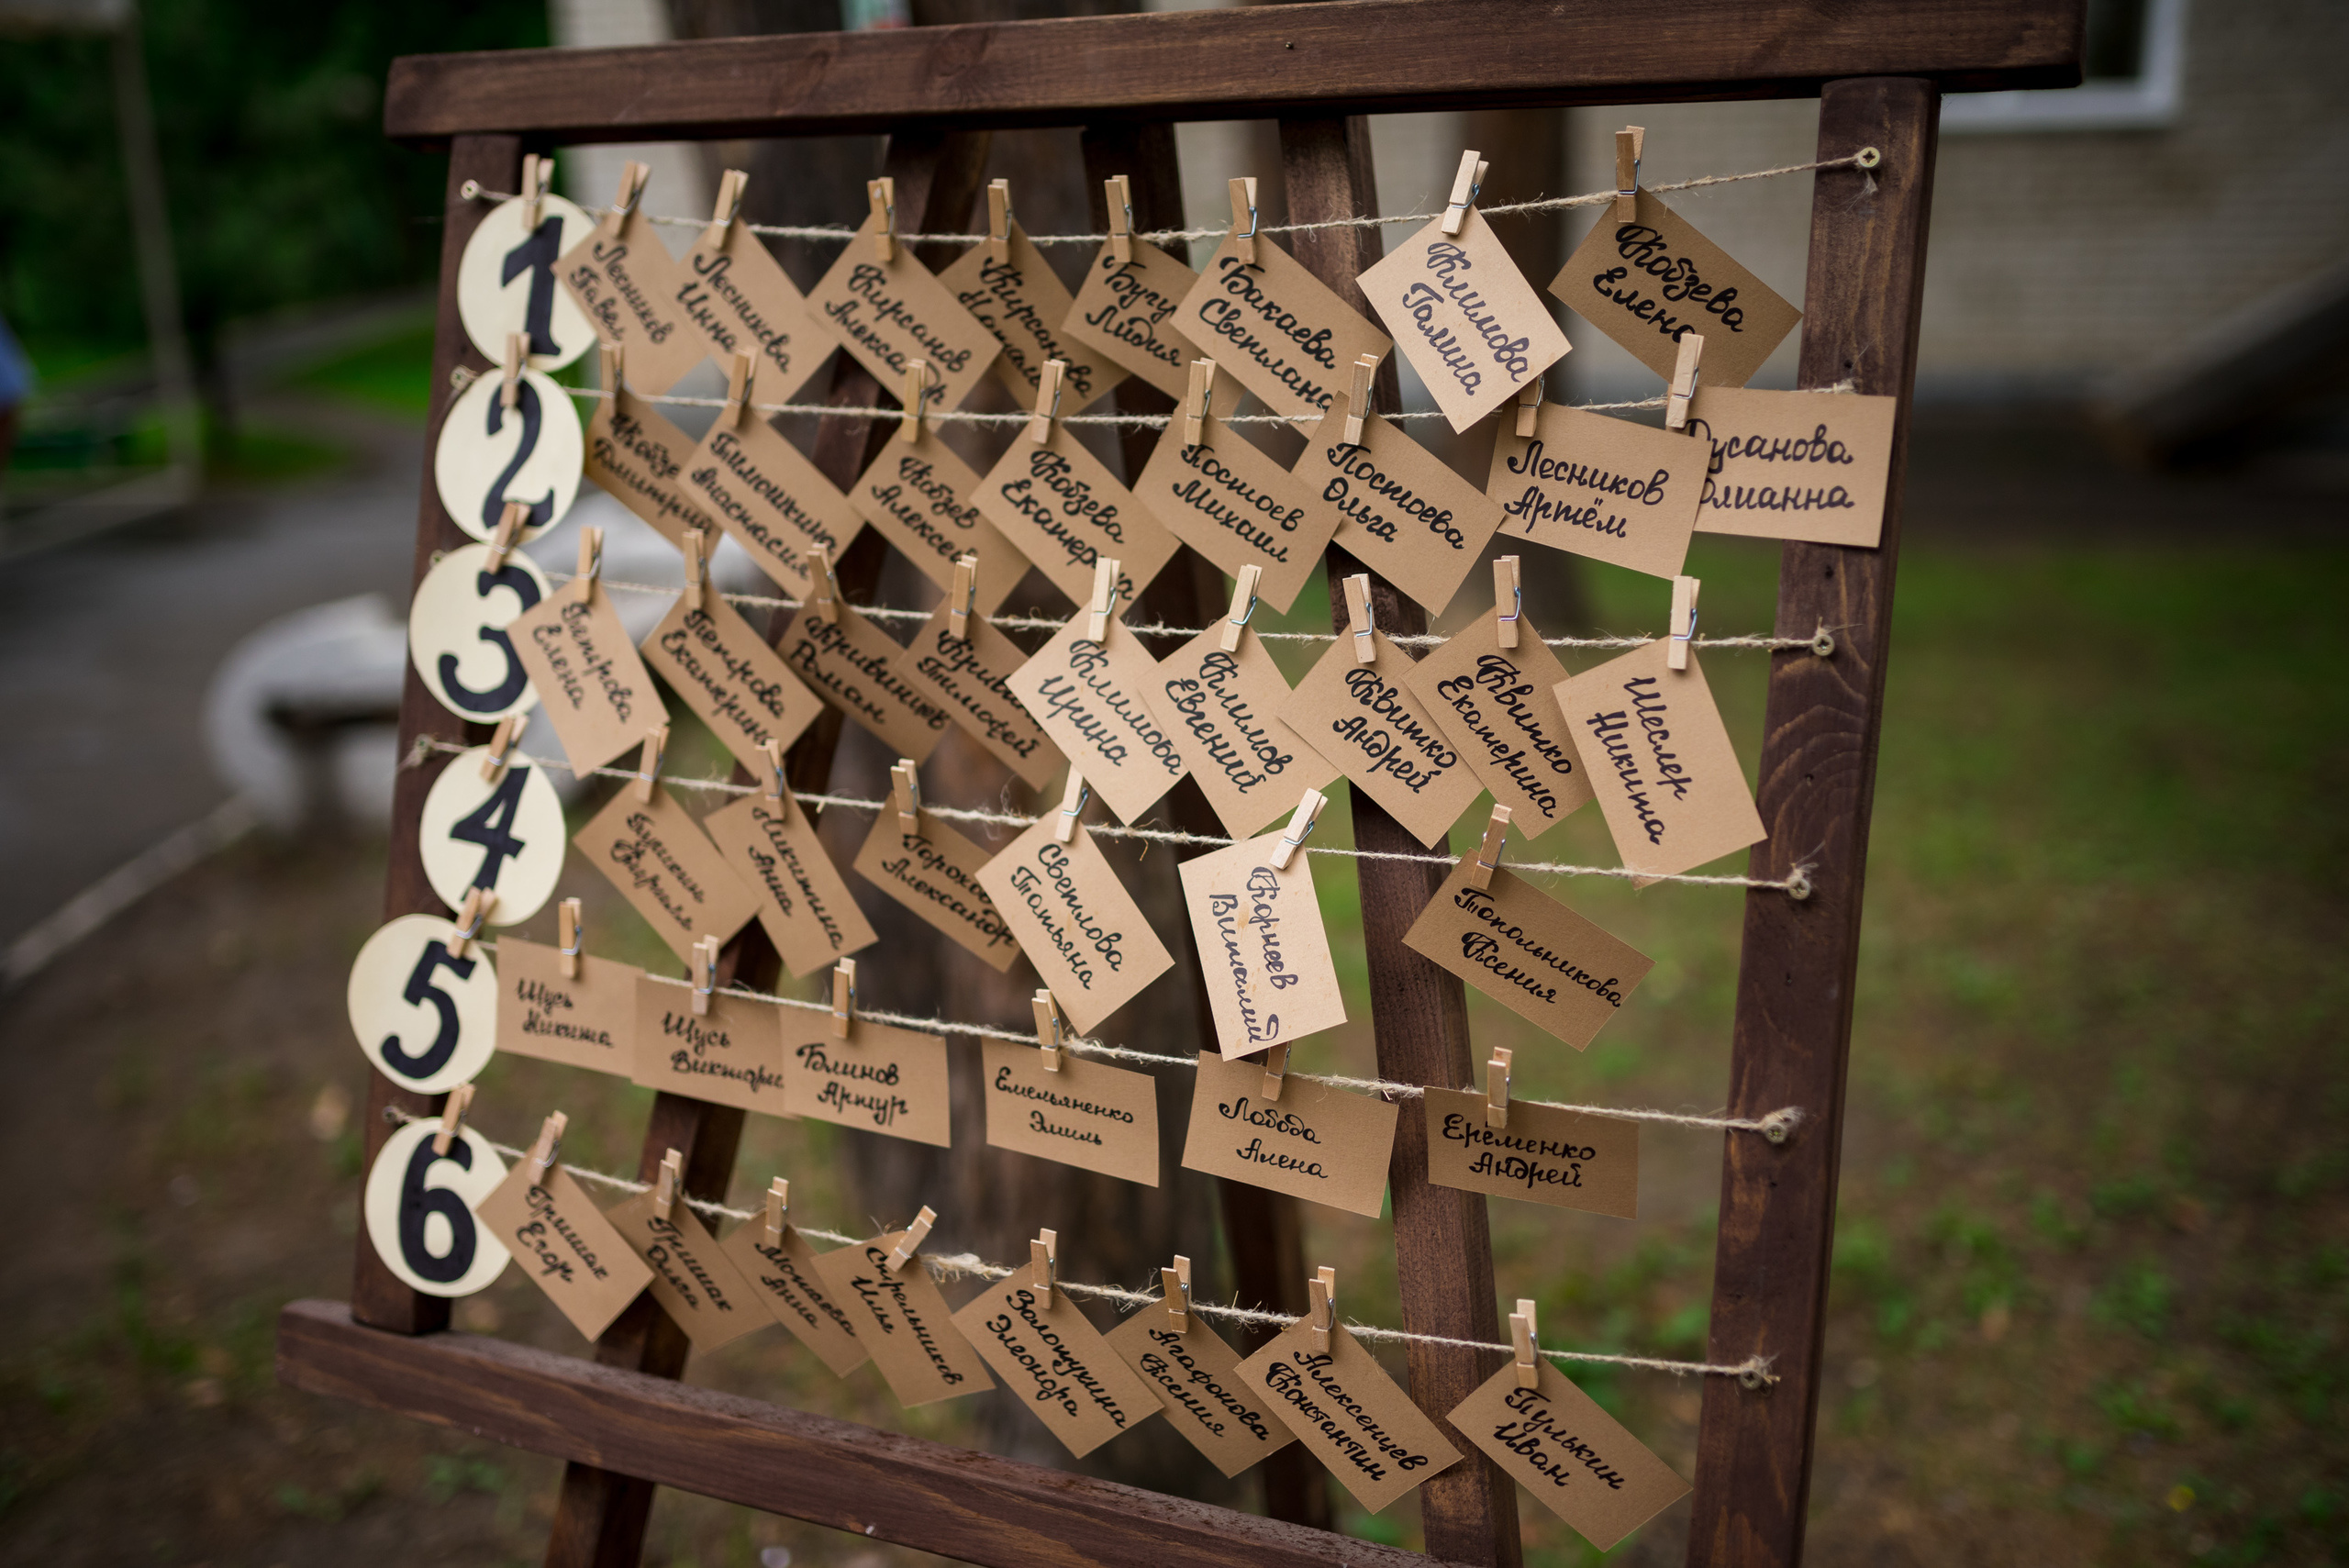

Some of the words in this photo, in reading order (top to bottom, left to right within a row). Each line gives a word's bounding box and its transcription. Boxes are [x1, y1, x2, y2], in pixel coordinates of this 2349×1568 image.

[501, 216, 563, 356] 1
[593, 241, 676, 345] Лесников
[676, 282, 738, 353] Инна
[694, 253, 789, 373] Лесникова
[848, 263, 972, 373] Кирсанов
[1219, 256, 1336, 370] Бакаева
[1427, 241, 1531, 384] Климова
[1615, 224, 1744, 332] Кобзева
[1085, 305, 1182, 368] Лидия
[1402, 282, 1483, 396] Галина
[481, 379, 554, 529] 2
[899, 456, 980, 529] Кобзев
[1030, 450, 1125, 544] Кобзева
[1180, 442, 1305, 532] Постоев
[1327, 442, 1464, 550] Постоева
[1508, 439, 1669, 506] Лесников
[1172, 479, 1288, 563] Михаил
[1322, 476, 1399, 543] Ольга
[1504, 485, 1627, 538] Артём
[438, 564, 541, 713] 3
[532, 624, 585, 711] Елена
[683, 608, 785, 720] Петрова
[789, 638, 887, 725] Роман
[1038, 674, 1129, 767] Ирина
[1069, 639, 1180, 776] Климова
[1164, 679, 1267, 795] Евгений
[1198, 651, 1294, 775] Климов
[1332, 716, 1442, 795] Андрей
[1344, 668, 1458, 769] Квитко
[1437, 675, 1555, 819] Екатерина
[1475, 654, 1573, 774] Квитко
[1622, 676, 1693, 801] Шеслер
[1586, 710, 1666, 846] Никита
[449, 765, 531, 902] 4
[747, 844, 792, 918] Анна
[881, 857, 1016, 949] Александр
[1010, 864, 1091, 990] Татьяна
[1038, 842, 1126, 973] Светлова
[1245, 865, 1299, 991] Корнеев
[1453, 887, 1622, 1009] Топольникова
[379, 940, 477, 1081] 5
[1208, 893, 1281, 1045] Виталий
[1461, 931, 1557, 1005] Ксения
[662, 1009, 731, 1056] Щусь
[796, 1042, 901, 1086] Блинов
[817, 1081, 909, 1128] Артур
[995, 1065, 1135, 1125] Емельяненко
[1029, 1108, 1104, 1147] Эмиль
[1218, 1096, 1322, 1145] Лобода
[398, 1132, 478, 1284] 6
[1235, 1138, 1330, 1180] Алена
[1468, 1151, 1583, 1189] Андрей
[516, 1220, 575, 1284] Егор
[646, 1243, 701, 1312] Ольга
[760, 1274, 820, 1329] Анна
[851, 1275, 894, 1335] Илья
[985, 1314, 1079, 1418] Элеонора
[1007, 1288, 1127, 1429] Золотухина
[1141, 1352, 1225, 1439] Ксения
[1149, 1329, 1269, 1441] Агафонова
[1265, 1362, 1388, 1483] Константин
[1293, 1351, 1430, 1472] Алексенцев
[1493, 1421, 1569, 1487] Иван
[1504, 1386, 1626, 1490] Пулькин
